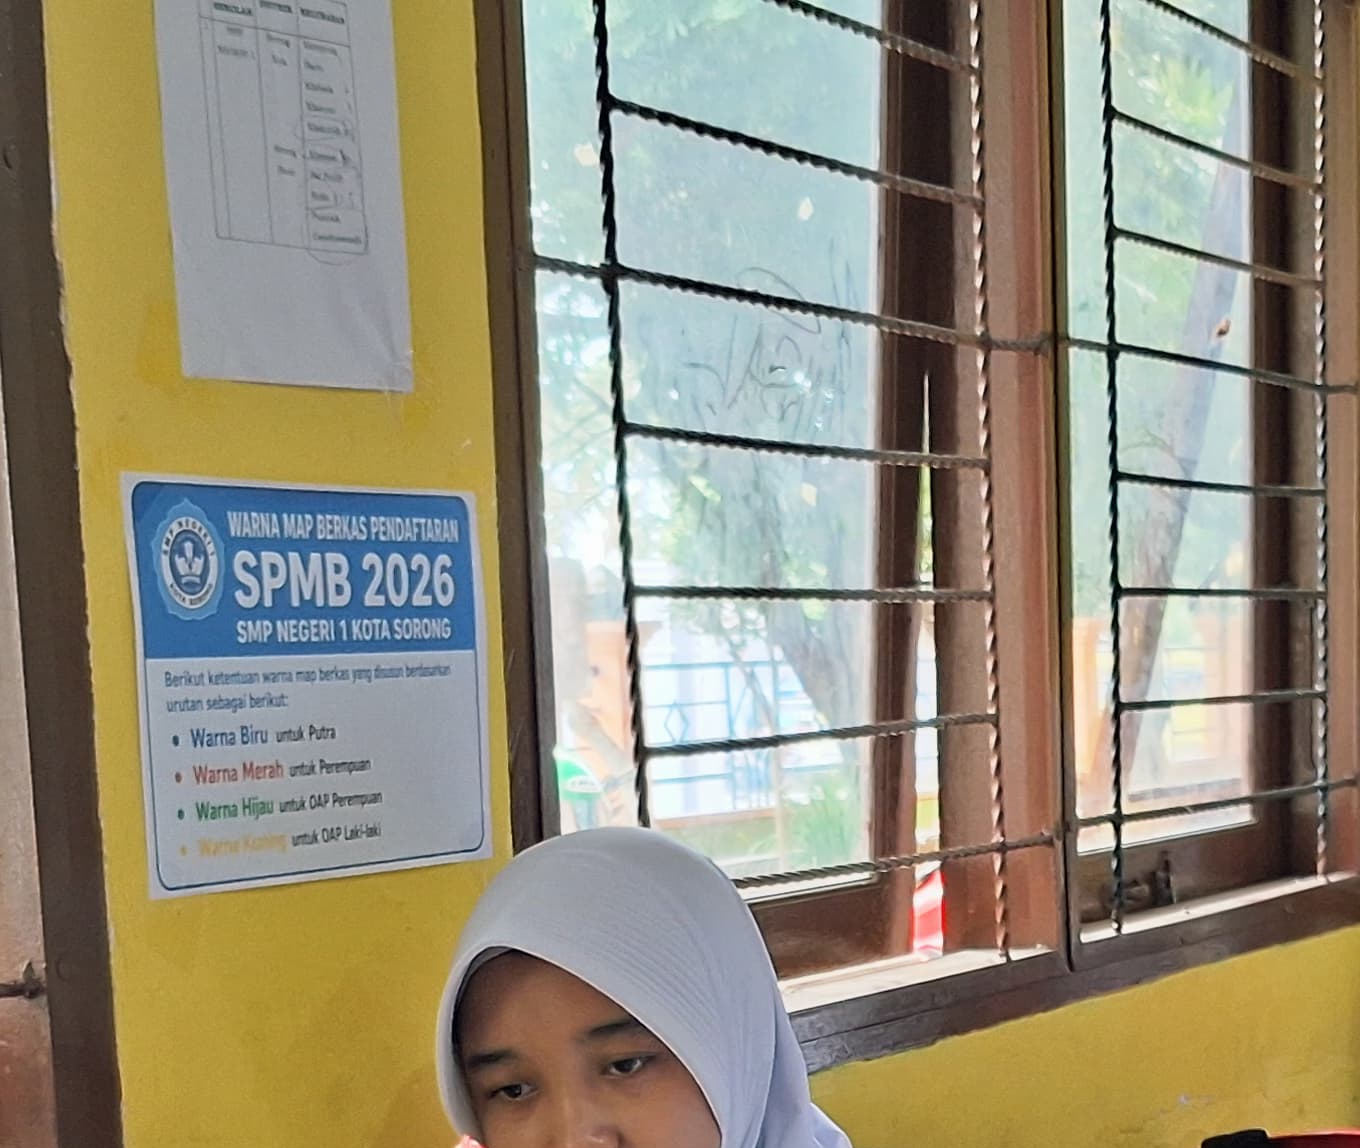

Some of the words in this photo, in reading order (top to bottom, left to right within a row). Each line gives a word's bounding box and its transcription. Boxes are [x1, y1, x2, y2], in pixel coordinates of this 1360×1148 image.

[227, 511, 280, 538] WARNA
[283, 513, 313, 539] MAP
[317, 514, 367, 541] BERKAS
[371, 516, 458, 543] PENDAFTARAN
[233, 550, 352, 608] SPMB
[361, 552, 455, 607] 2026
[237, 620, 272, 643] SMP
[276, 619, 334, 642] NEGERI
[340, 619, 347, 641] 1
[352, 618, 390, 641] KOTA
[394, 618, 452, 640] SORONG
[164, 671, 205, 687] Berikut
[166, 697, 204, 713] urutan
[206, 694, 245, 713] sebagai
[191, 727, 235, 748] Warna
[240, 724, 268, 745] Biru
[276, 726, 304, 743] untuk
[309, 724, 336, 741] Putra
[193, 764, 238, 784] Warna
[243, 760, 284, 781] Merah
[290, 761, 316, 777] untuk
[196, 801, 238, 821] Warna
[242, 796, 274, 819] Hijau
[279, 797, 306, 813] untuk
[310, 794, 330, 810] OAP
[292, 830, 318, 847] untuk
